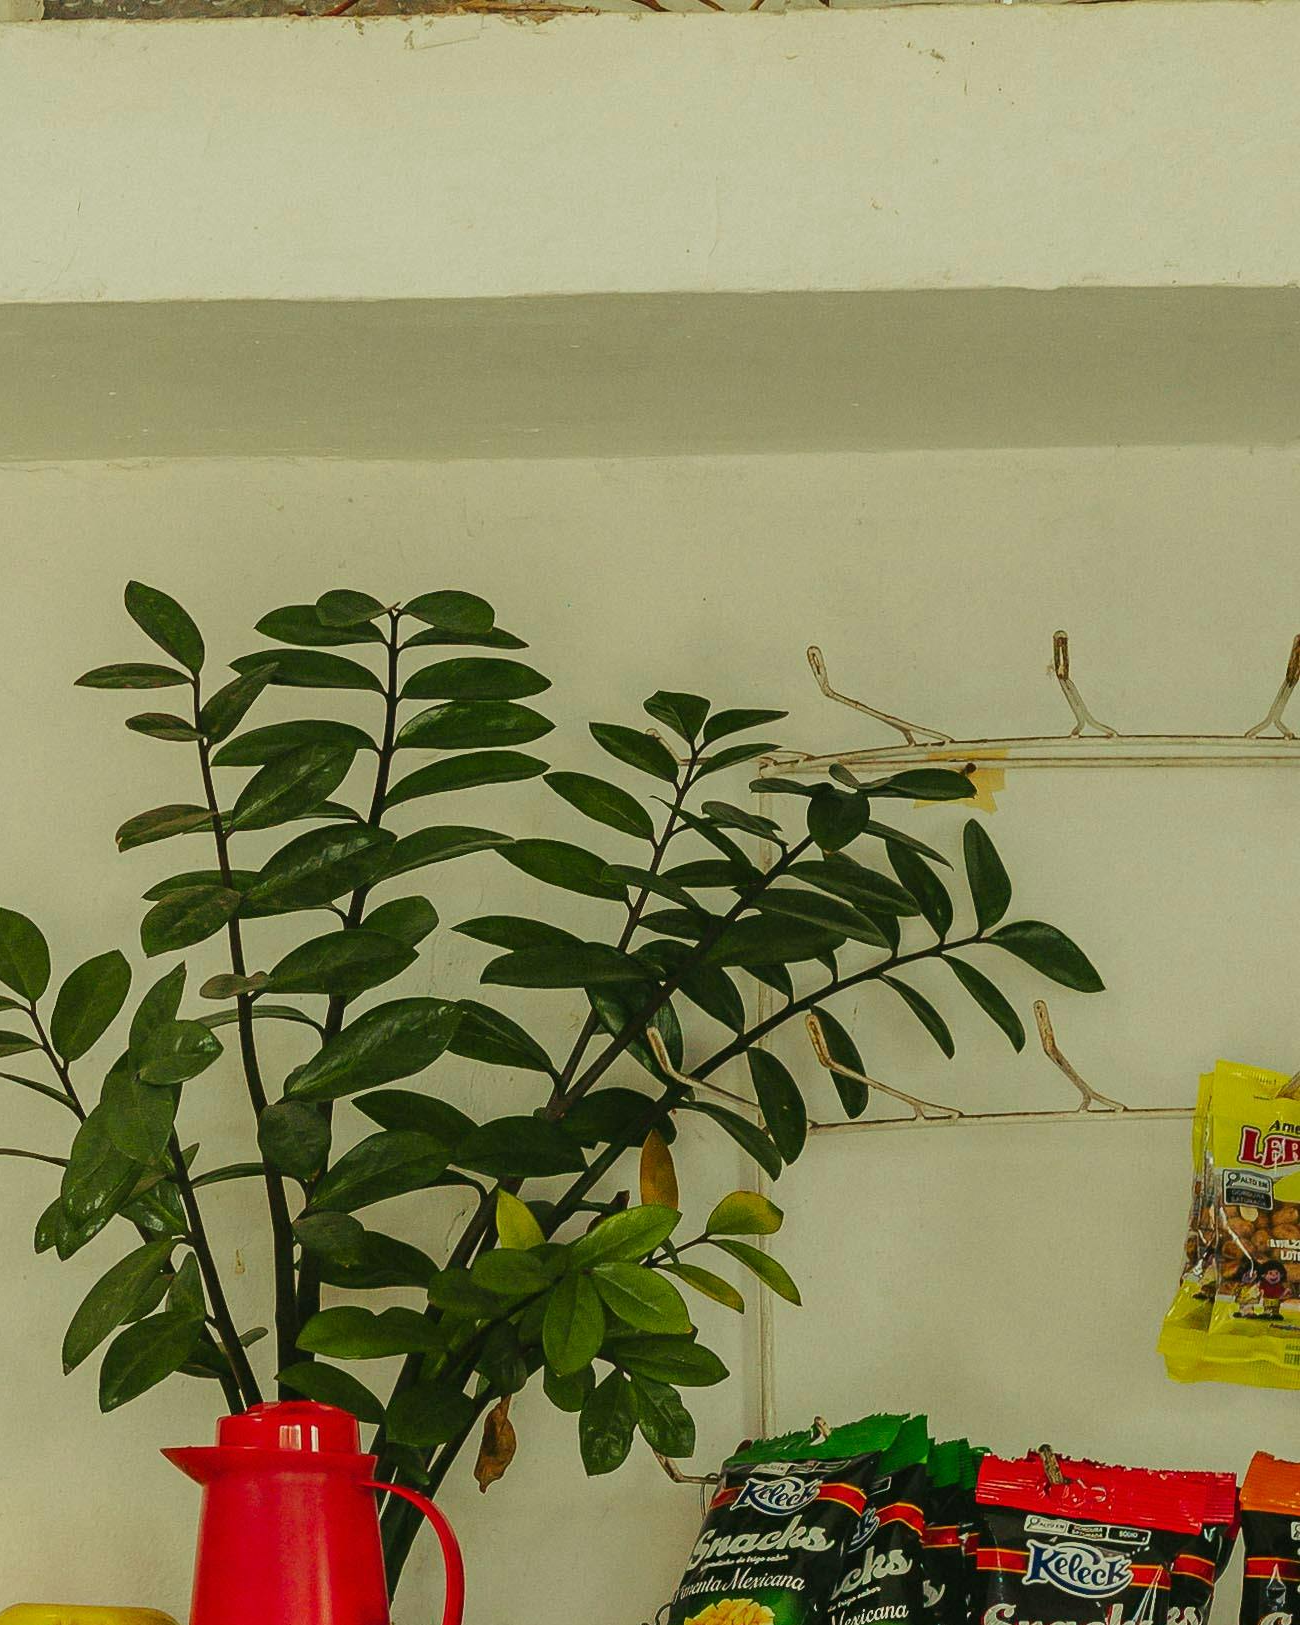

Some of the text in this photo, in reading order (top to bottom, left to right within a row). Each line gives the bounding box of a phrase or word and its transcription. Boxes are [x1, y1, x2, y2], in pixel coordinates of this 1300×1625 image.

[686, 1514, 835, 1571] Snacks
[1022, 1540, 1134, 1598] Keleck
[722, 1568, 806, 1591] Mexicana
